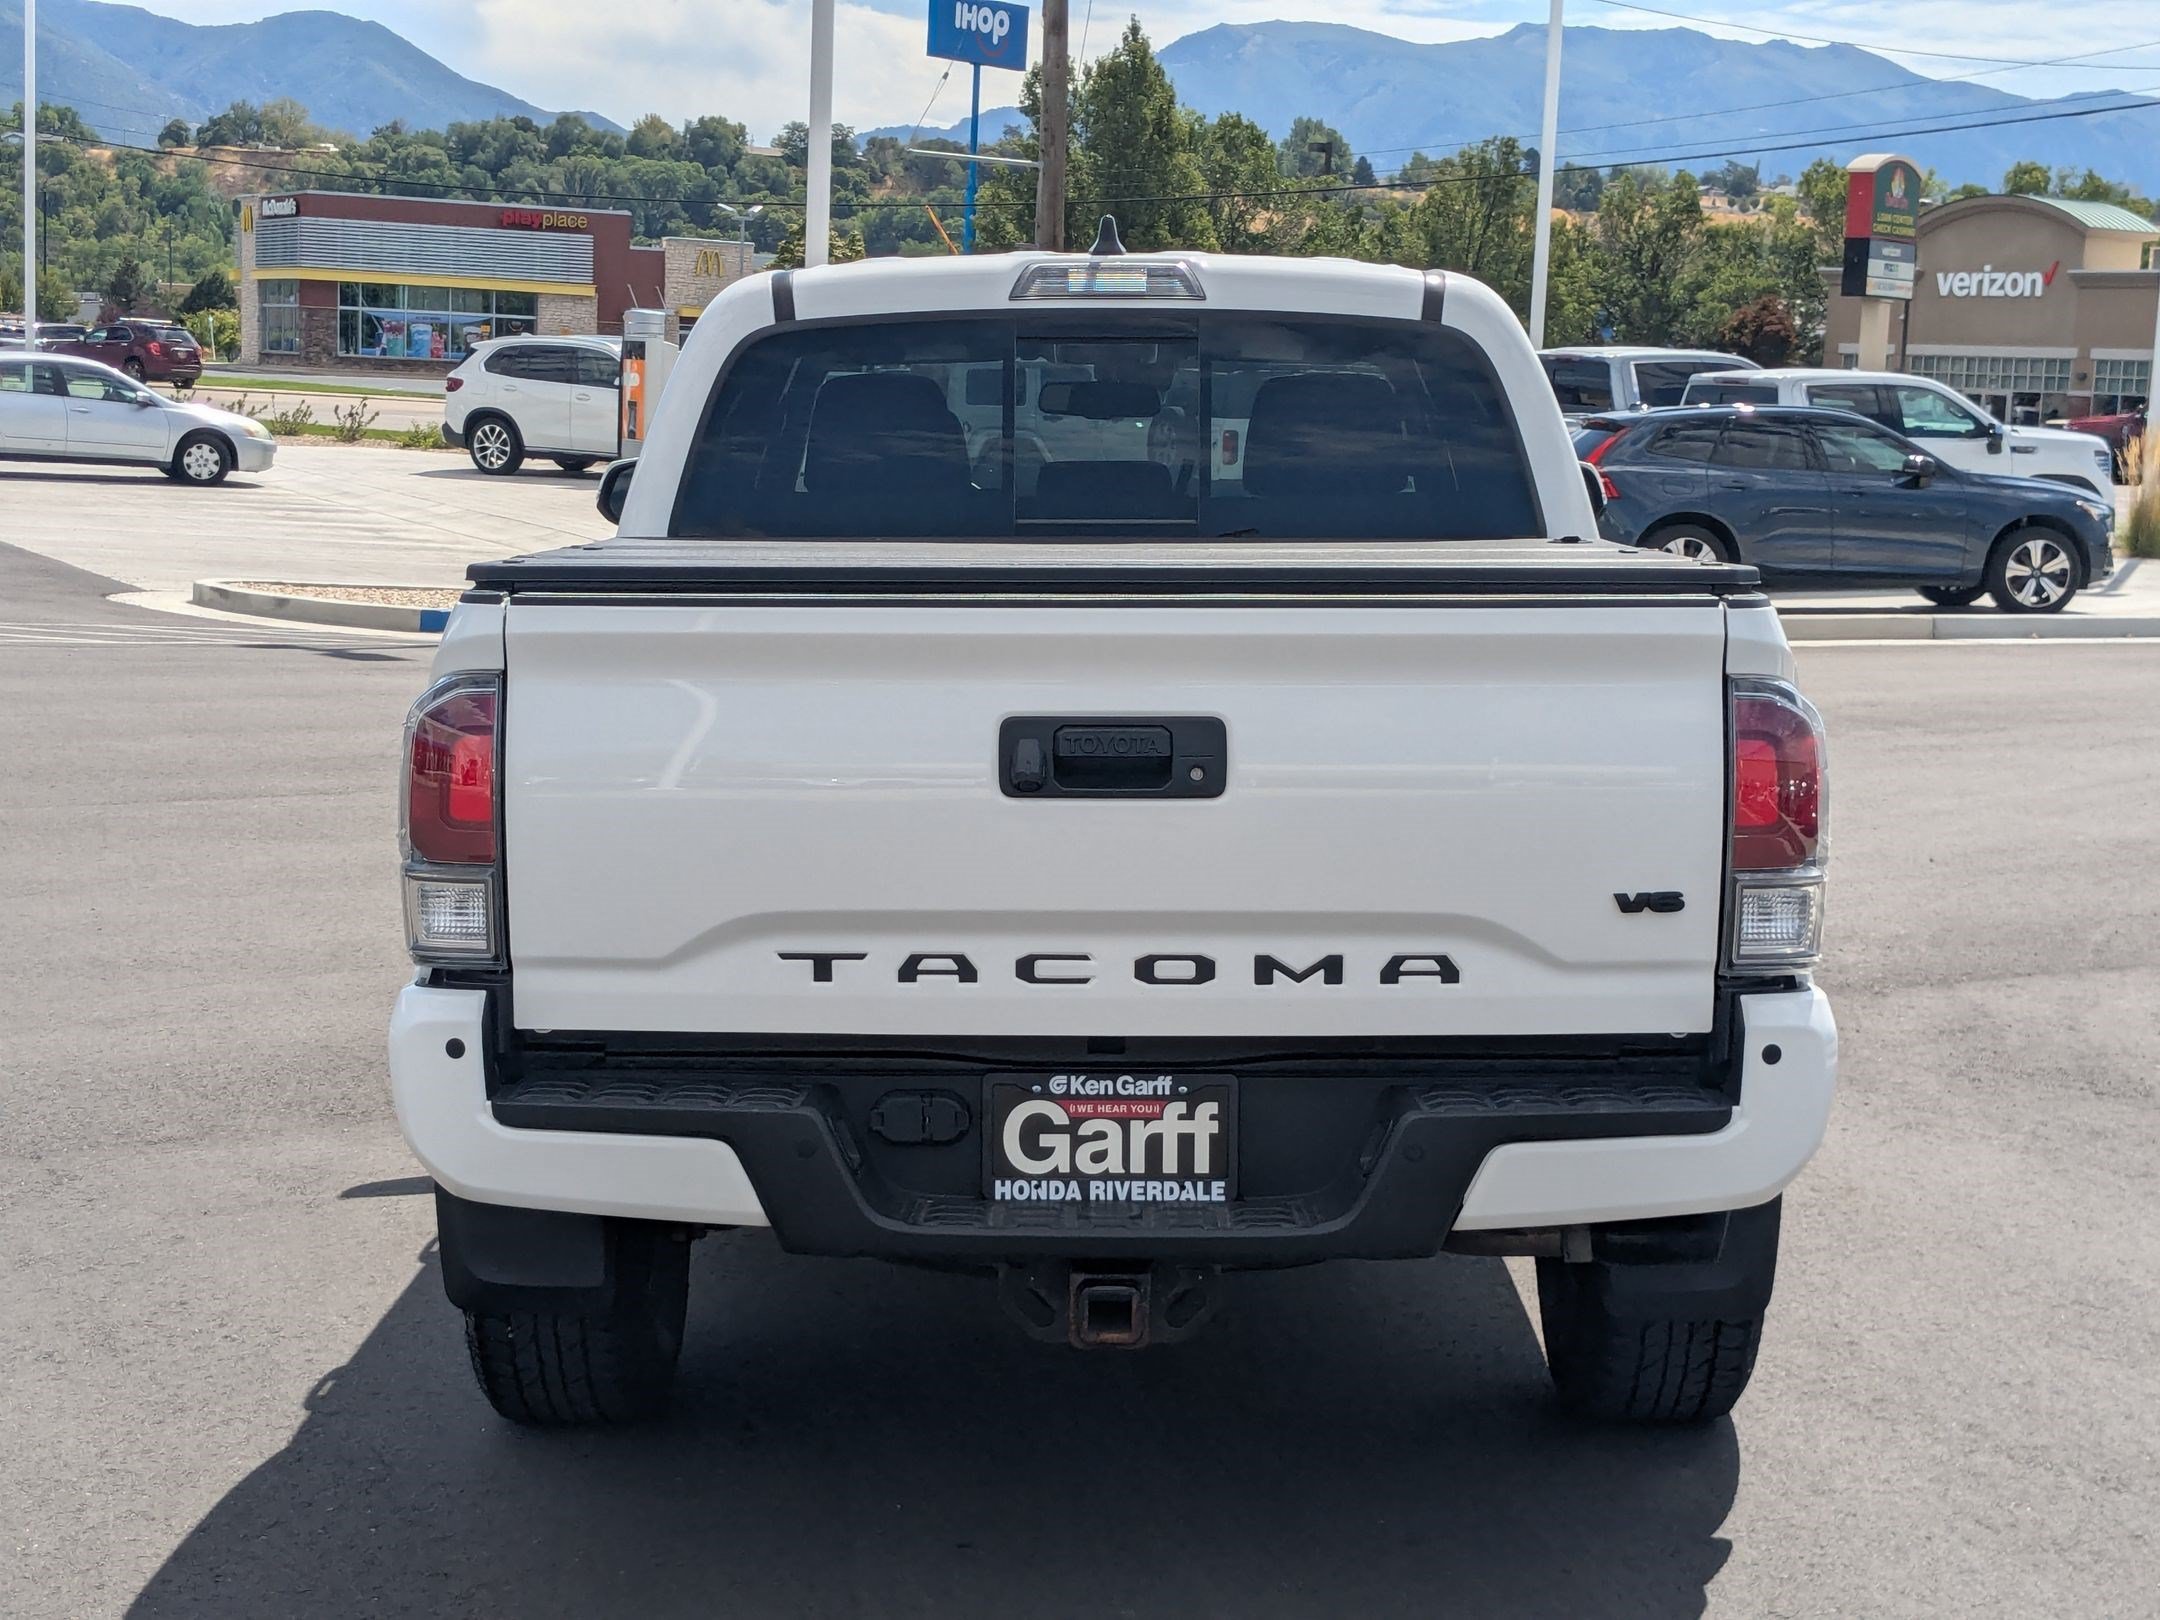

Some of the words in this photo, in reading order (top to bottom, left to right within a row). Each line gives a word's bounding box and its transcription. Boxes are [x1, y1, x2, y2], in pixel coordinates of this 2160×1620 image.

[1936, 264, 2044, 297] verizon
[1064, 736, 1162, 755] TOYOTA
[1612, 891, 1686, 914] V6
[776, 951, 1462, 986] TACOMA
[1070, 1075, 1113, 1096] Ken
[1116, 1075, 1173, 1096] Garff
[1077, 1103, 1095, 1114] WE
[1097, 1103, 1128, 1114] HEAR
[1130, 1103, 1153, 1114] YOU
[1003, 1100, 1219, 1175] Garff
[994, 1179, 1082, 1201] HONDA
[1089, 1180, 1226, 1202] RIVERDALE
